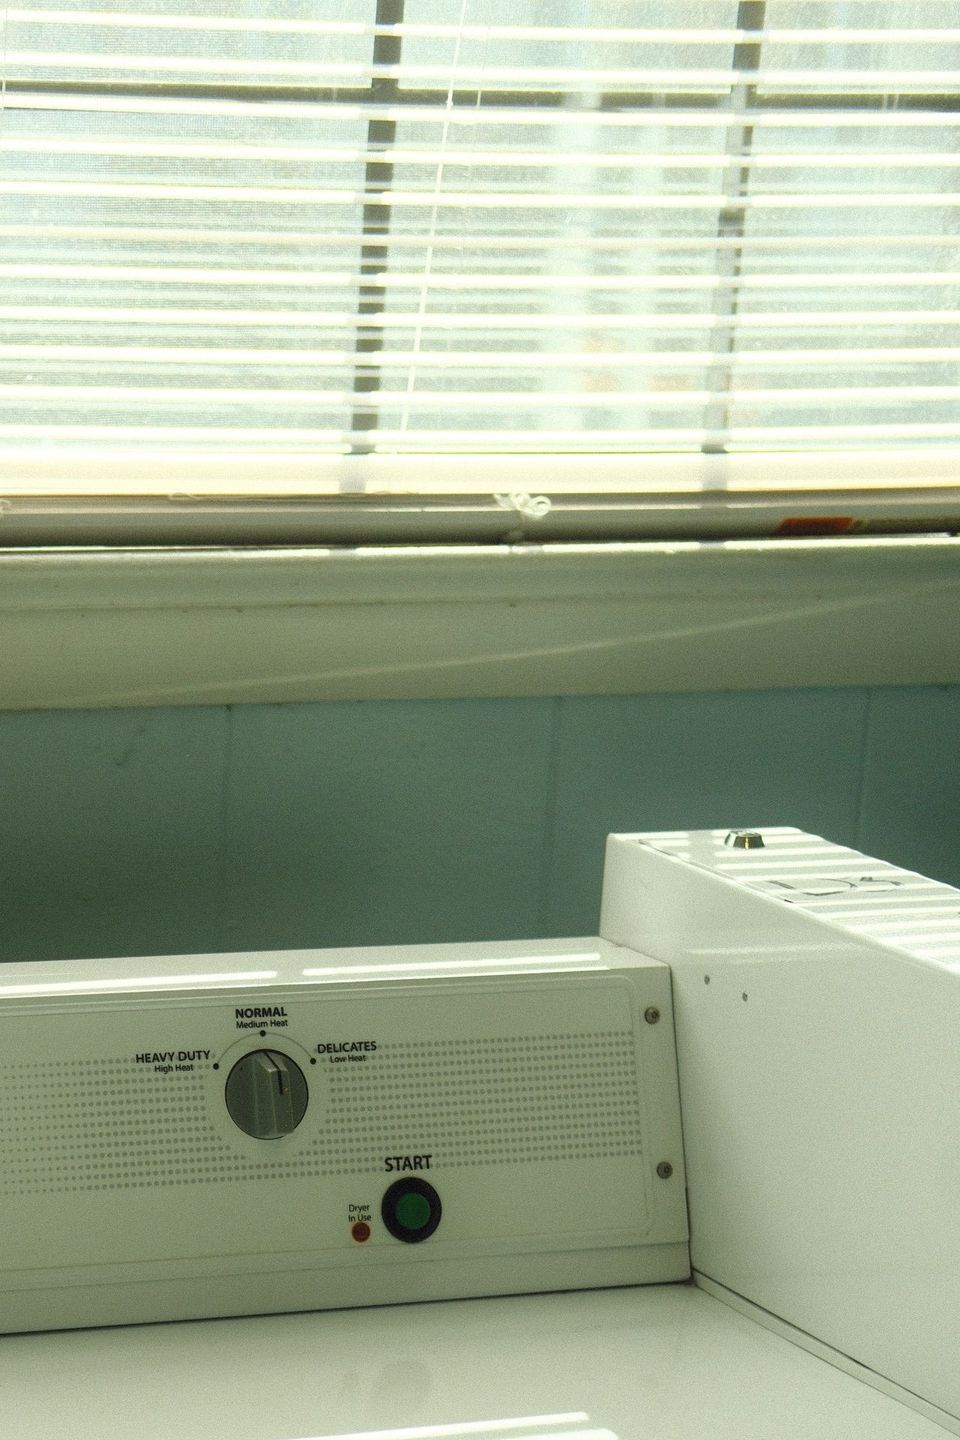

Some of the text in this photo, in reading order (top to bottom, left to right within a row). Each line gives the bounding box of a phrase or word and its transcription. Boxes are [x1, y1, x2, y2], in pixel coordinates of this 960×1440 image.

[235, 1006, 288, 1019] NORMAL
[235, 1019, 289, 1029] Medium Heat
[317, 1041, 377, 1054] DELICATES
[135, 1050, 211, 1064] HEAVY DUTY
[329, 1054, 367, 1064] Low Heat
[154, 1063, 194, 1075] High Heat
[384, 1155, 432, 1172] START
[348, 1204, 370, 1213] Dryer
[357, 1214, 372, 1222] Use
